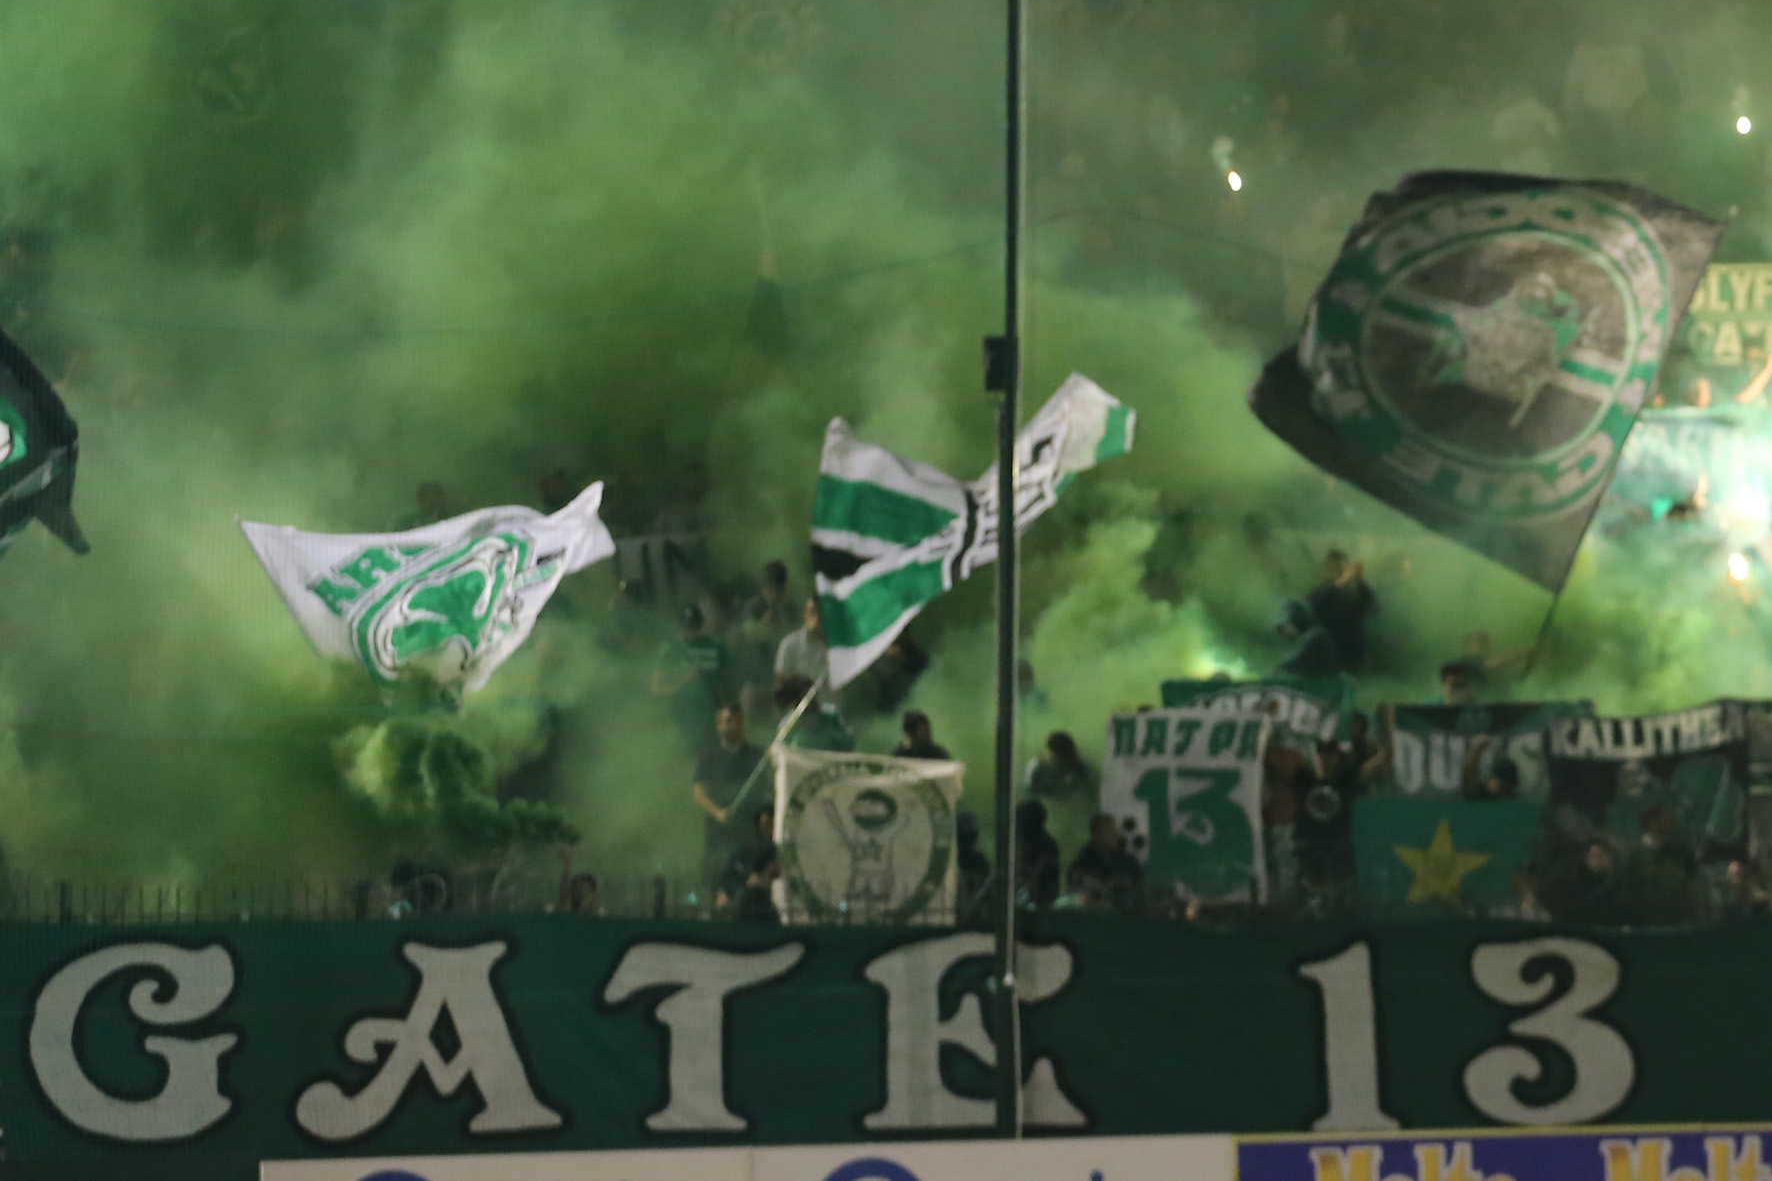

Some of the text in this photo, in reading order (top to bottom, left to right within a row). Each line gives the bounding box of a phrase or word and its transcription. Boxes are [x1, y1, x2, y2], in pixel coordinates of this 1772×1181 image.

[1134, 766, 1254, 899] 13
[30, 932, 1637, 1140] GATE 13
